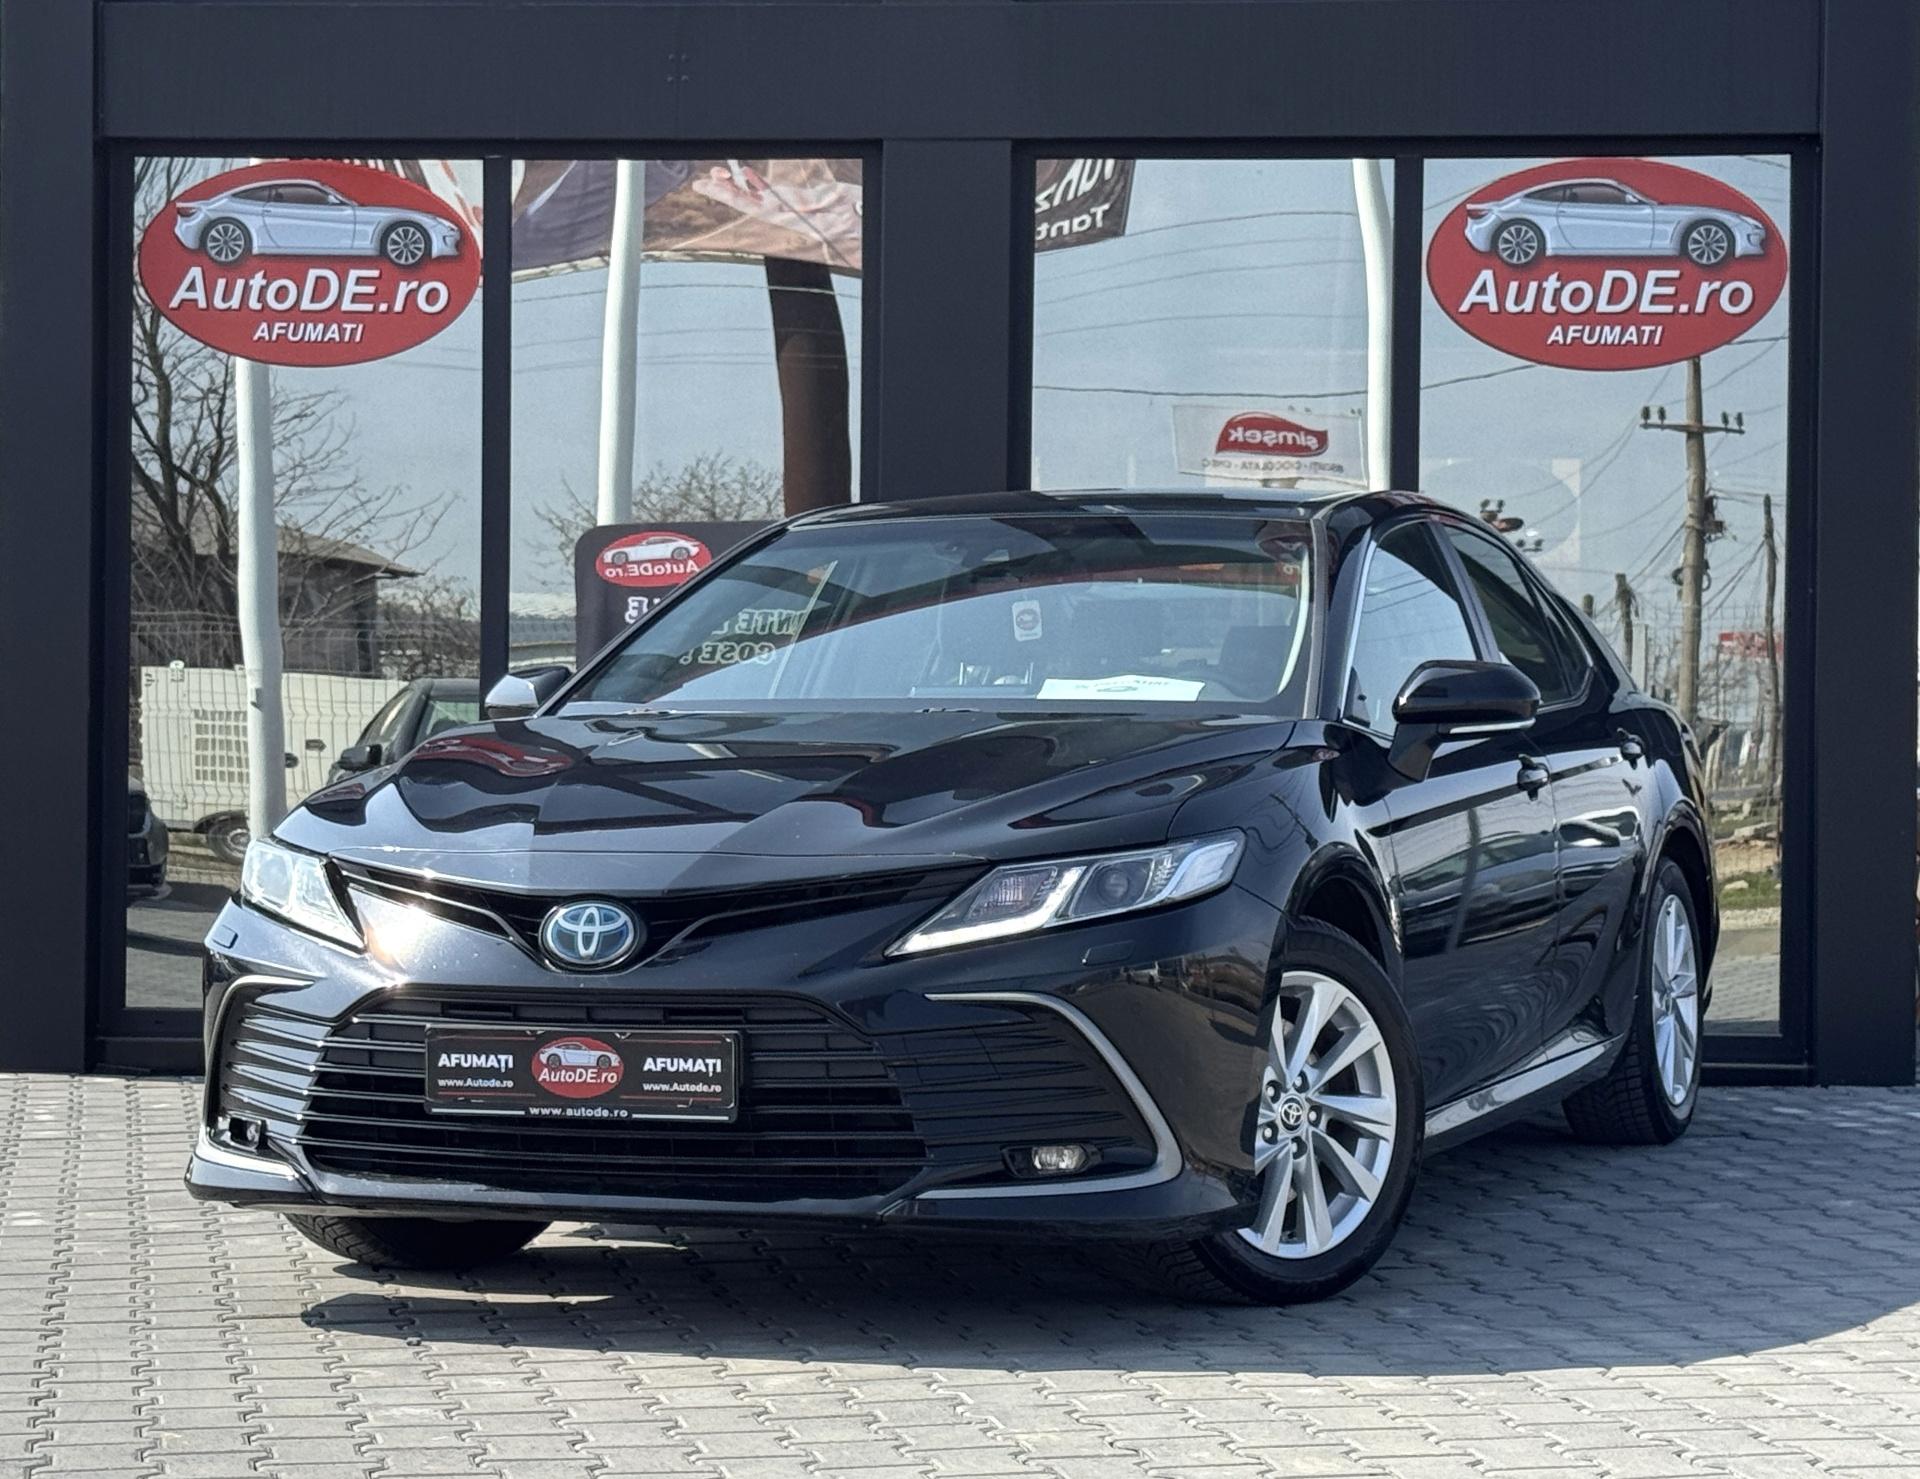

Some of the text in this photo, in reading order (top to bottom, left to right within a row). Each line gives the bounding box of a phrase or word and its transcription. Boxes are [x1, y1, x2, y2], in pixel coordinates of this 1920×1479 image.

[169, 266, 449, 314] AutoDE.ro
[1459, 268, 1754, 316] AutoDE.ro
[253, 321, 364, 344] AFUMATI
[1547, 324, 1663, 347] AFUMATI
[437, 1077, 514, 1088] www.Autode.ro
[538, 1067, 618, 1084] AutoDE.ro
[642, 1082, 722, 1093] www.Autode.ro
[528, 1106, 629, 1118] www.autode.ro
